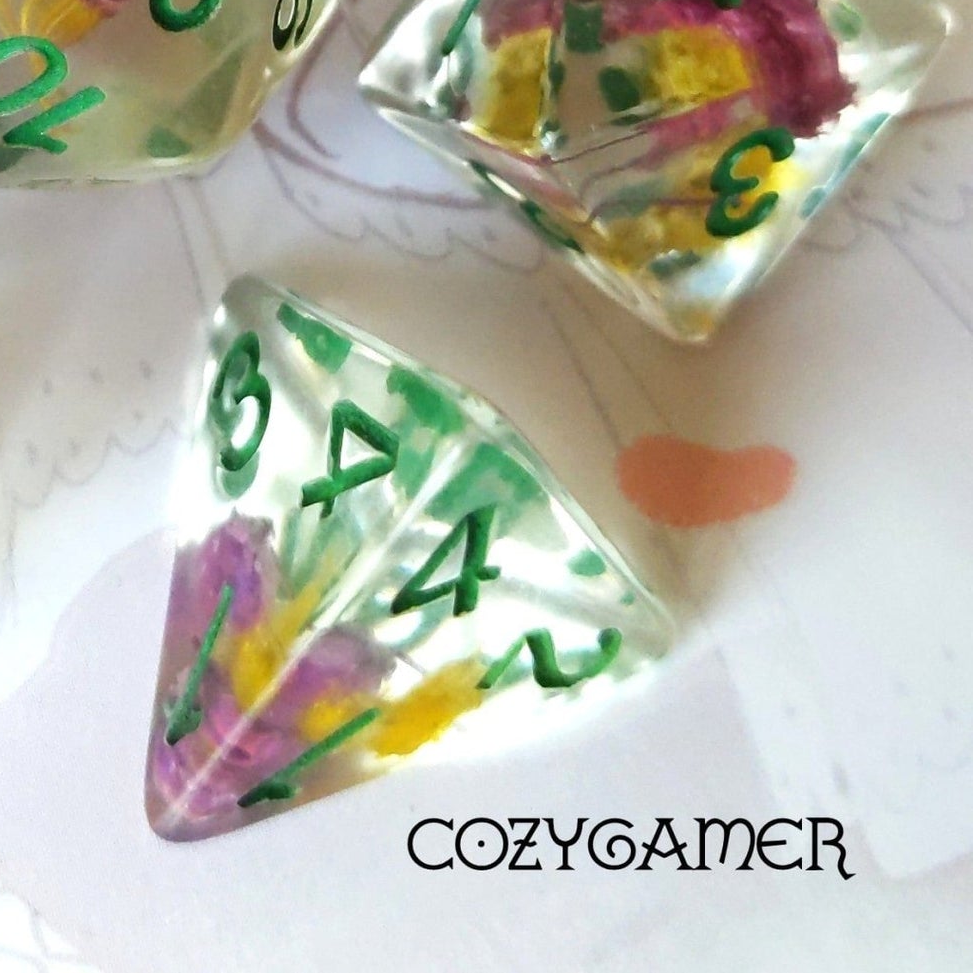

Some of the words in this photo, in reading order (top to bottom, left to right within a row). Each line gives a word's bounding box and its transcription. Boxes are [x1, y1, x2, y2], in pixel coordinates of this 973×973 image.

[705, 128, 795, 238] 3
[302, 398, 400, 518] 4
[392, 504, 501, 617] 4
